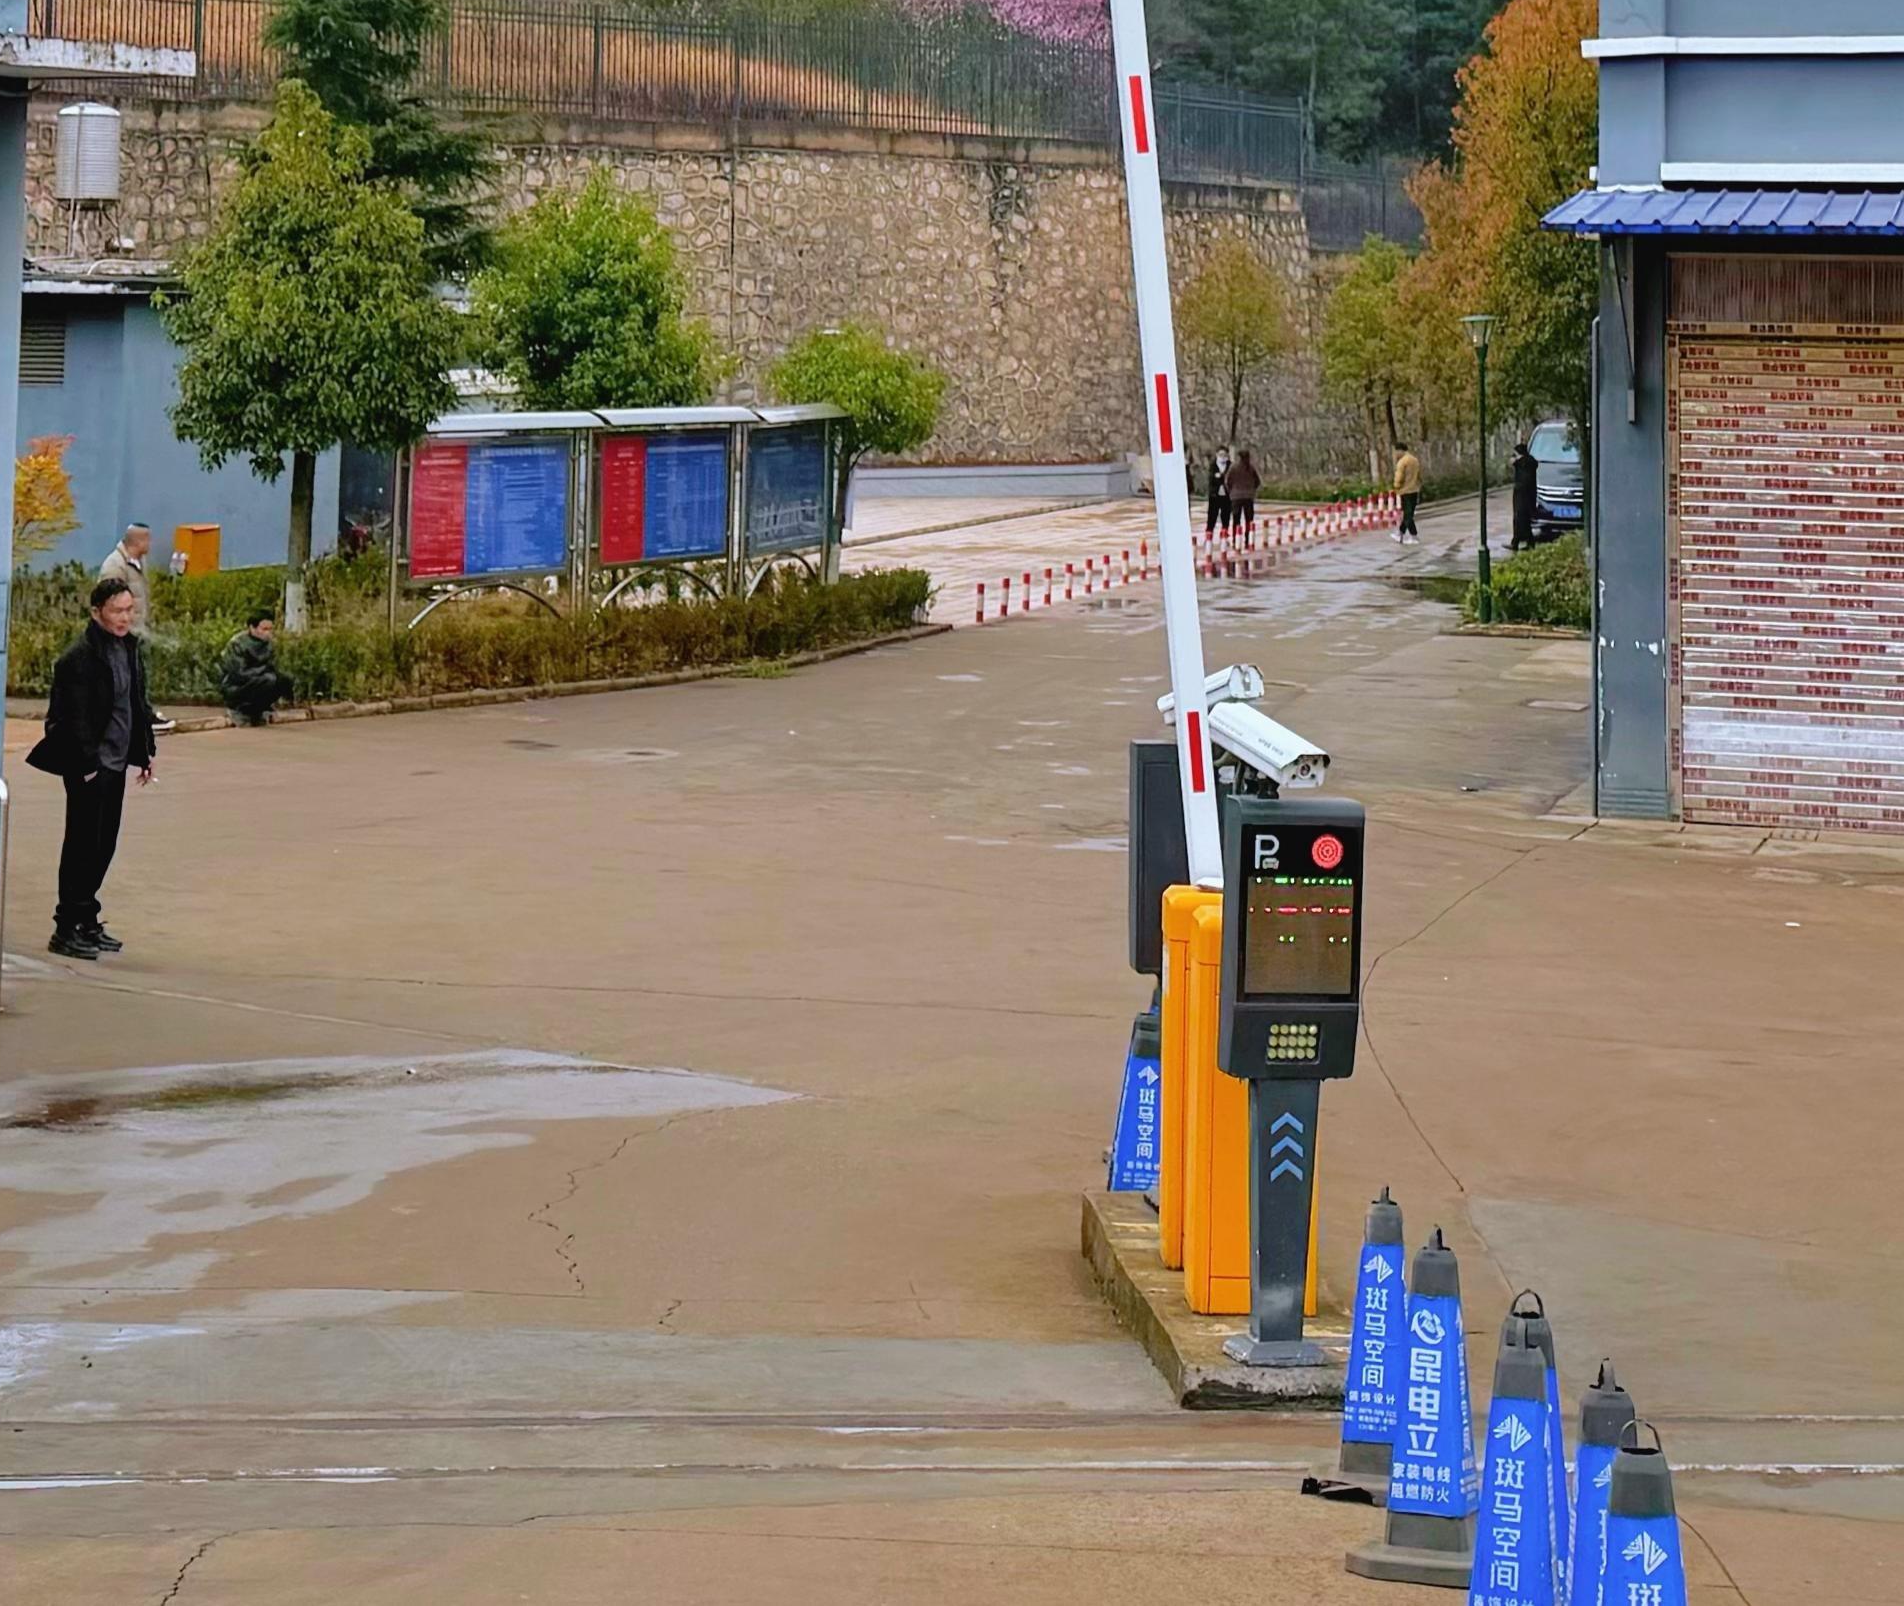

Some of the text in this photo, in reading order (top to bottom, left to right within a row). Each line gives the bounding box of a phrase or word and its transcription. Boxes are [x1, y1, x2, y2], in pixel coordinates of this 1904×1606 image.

[1137, 1088, 1155, 1159] 斑马空间
[1362, 1287, 1388, 1388] 斑马空间
[1406, 1347, 1442, 1457] 昆电立
[1390, 1482, 1450, 1503] 阻燃防火
[1392, 1462, 1451, 1483] 家装电线
[1490, 1458, 1525, 1592] 斑马空间
